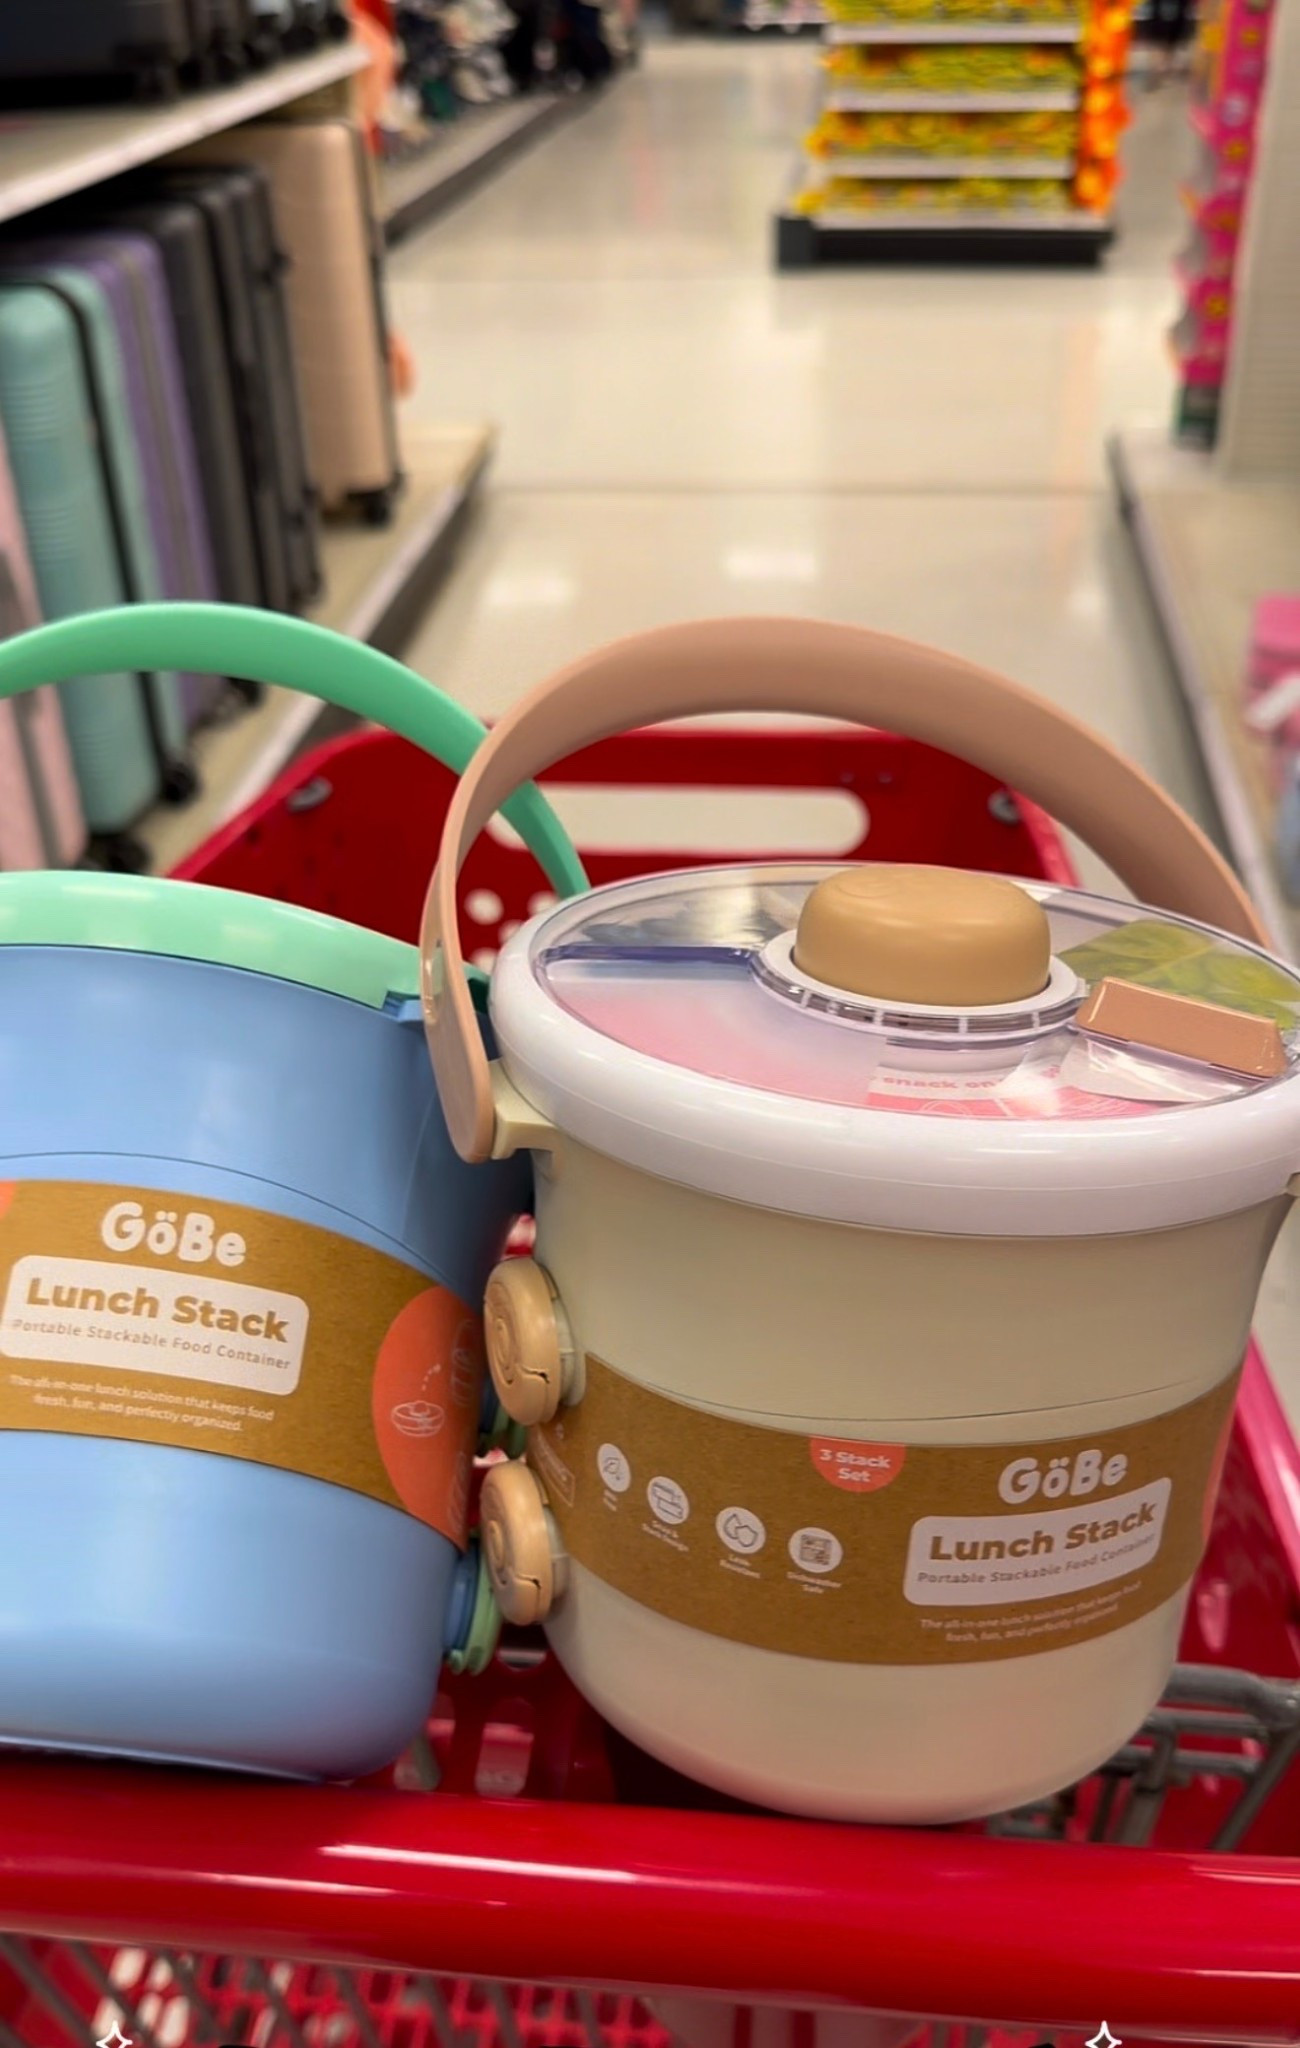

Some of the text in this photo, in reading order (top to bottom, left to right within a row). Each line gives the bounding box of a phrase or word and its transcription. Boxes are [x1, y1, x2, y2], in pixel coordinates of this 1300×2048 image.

[883, 1076, 958, 1089] snack
[101, 1201, 246, 1267] GöBe
[27, 1277, 289, 1343] Lunch Stack
[11, 1319, 291, 1369] Portable Stackable Food Container
[247, 1406, 274, 1421] food
[819, 1449, 892, 1469] 3 Stack
[837, 1467, 871, 1483] Set
[998, 1449, 1128, 1504] GöBe
[930, 1502, 1157, 1561] Lunch Stack
[917, 1571, 985, 1584] Portable
[990, 1564, 1062, 1583] Stackable
[1066, 1553, 1098, 1571] Food
